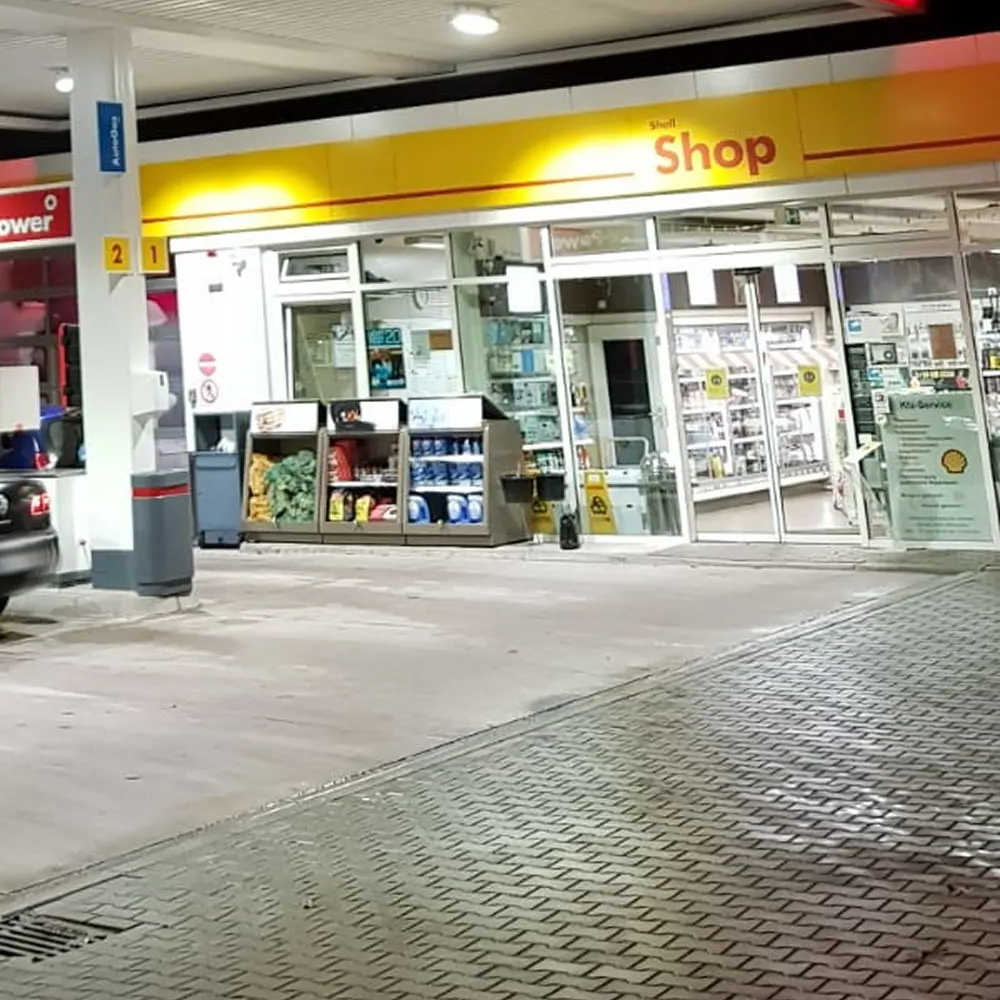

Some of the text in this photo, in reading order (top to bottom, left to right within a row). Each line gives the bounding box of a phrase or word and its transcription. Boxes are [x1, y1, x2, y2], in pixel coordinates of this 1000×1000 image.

[649, 118, 676, 130] Shell
[654, 131, 776, 176] Shop
[111, 243, 123, 264] 2
[150, 245, 157, 264] 1
